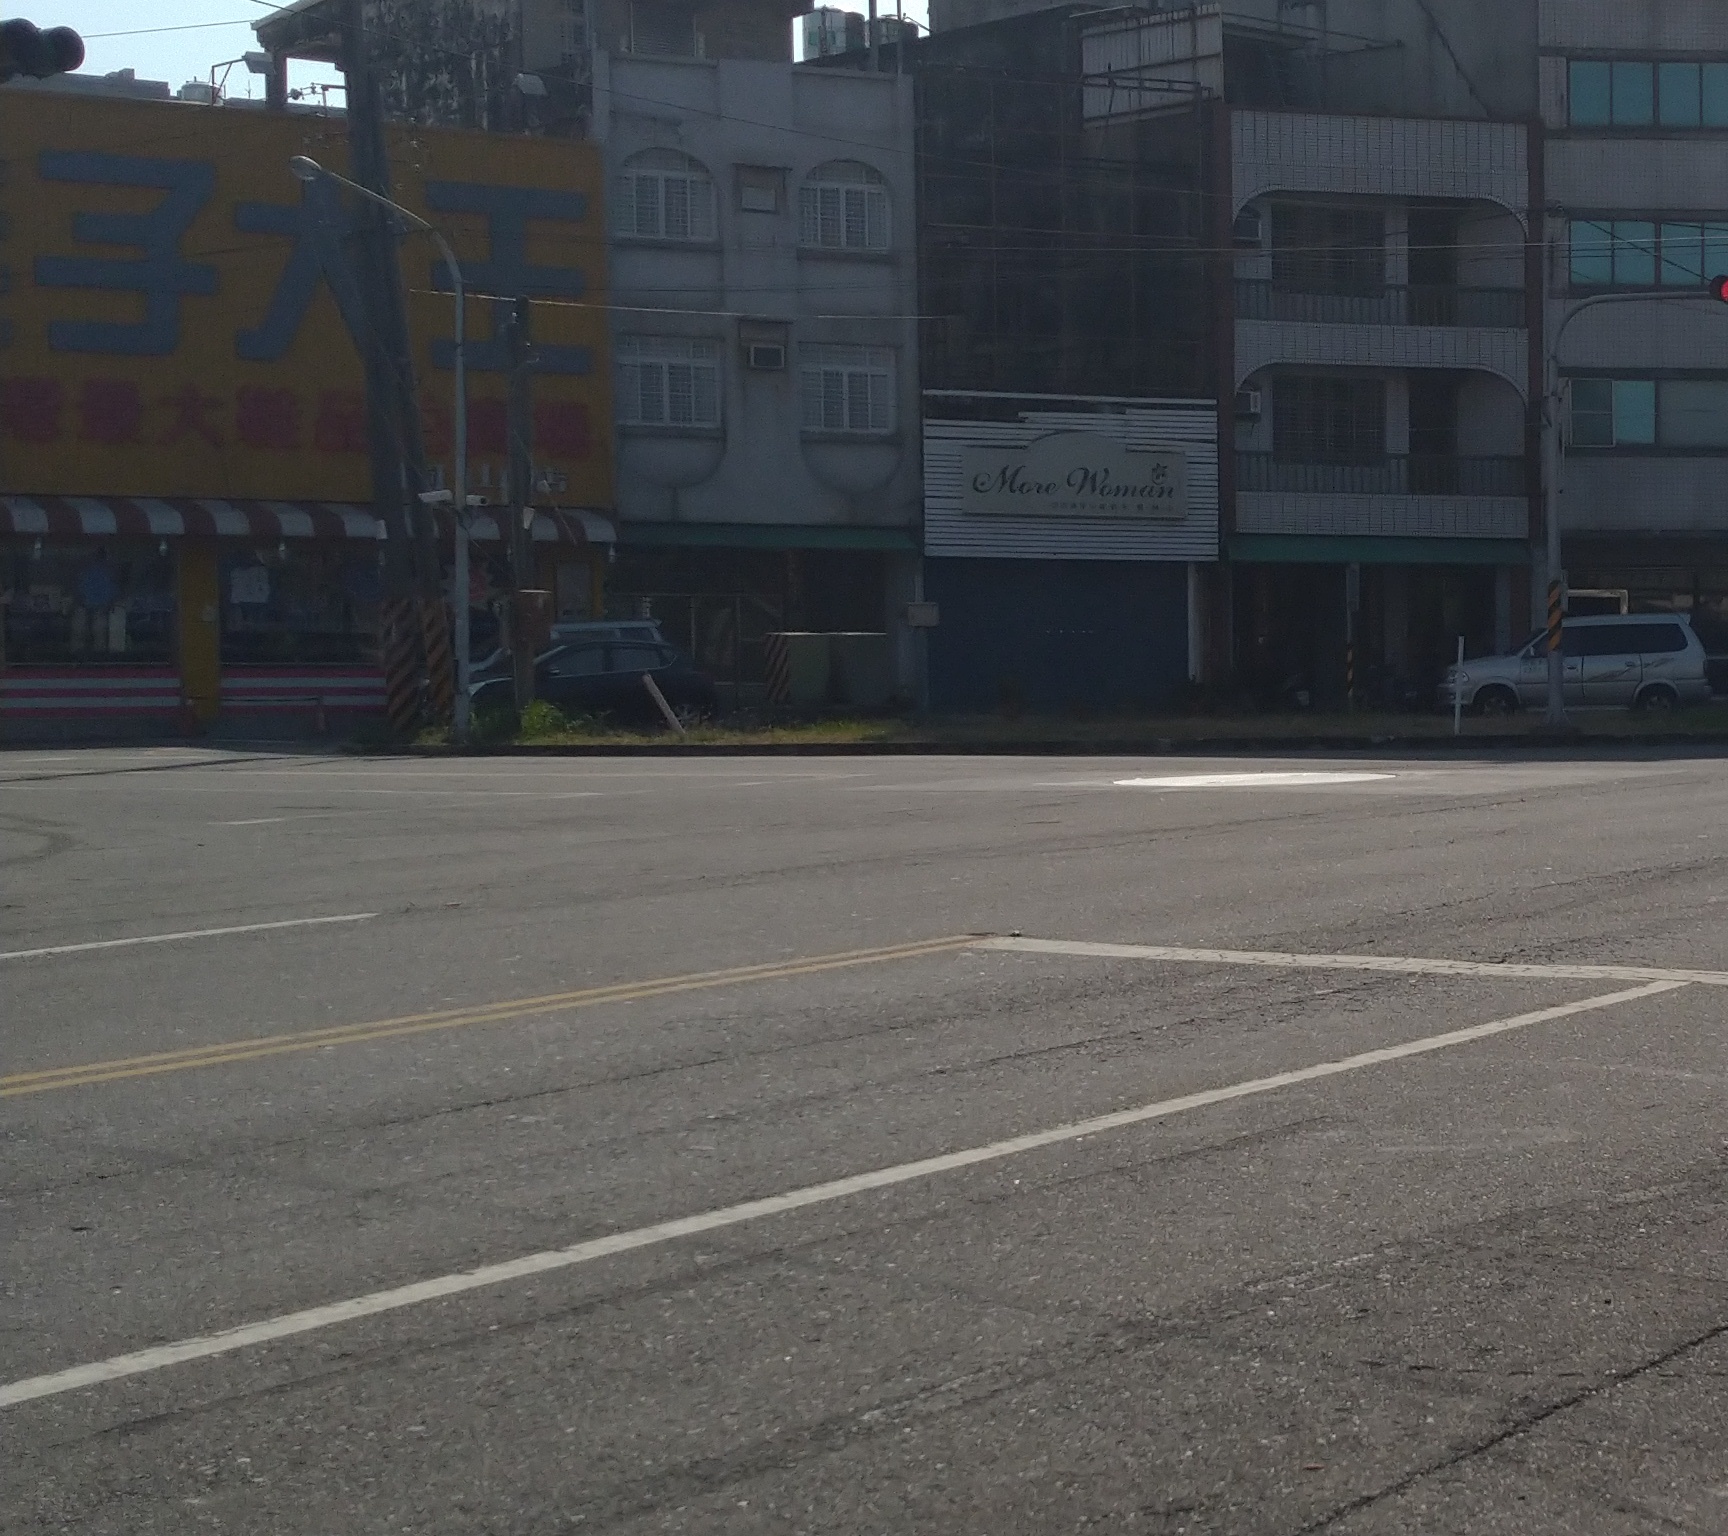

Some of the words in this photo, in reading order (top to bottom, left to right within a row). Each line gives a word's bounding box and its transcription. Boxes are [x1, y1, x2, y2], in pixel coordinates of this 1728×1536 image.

[0, 150, 594, 376] 子大王
[972, 464, 1059, 495] More
[1067, 467, 1174, 500] Woman
